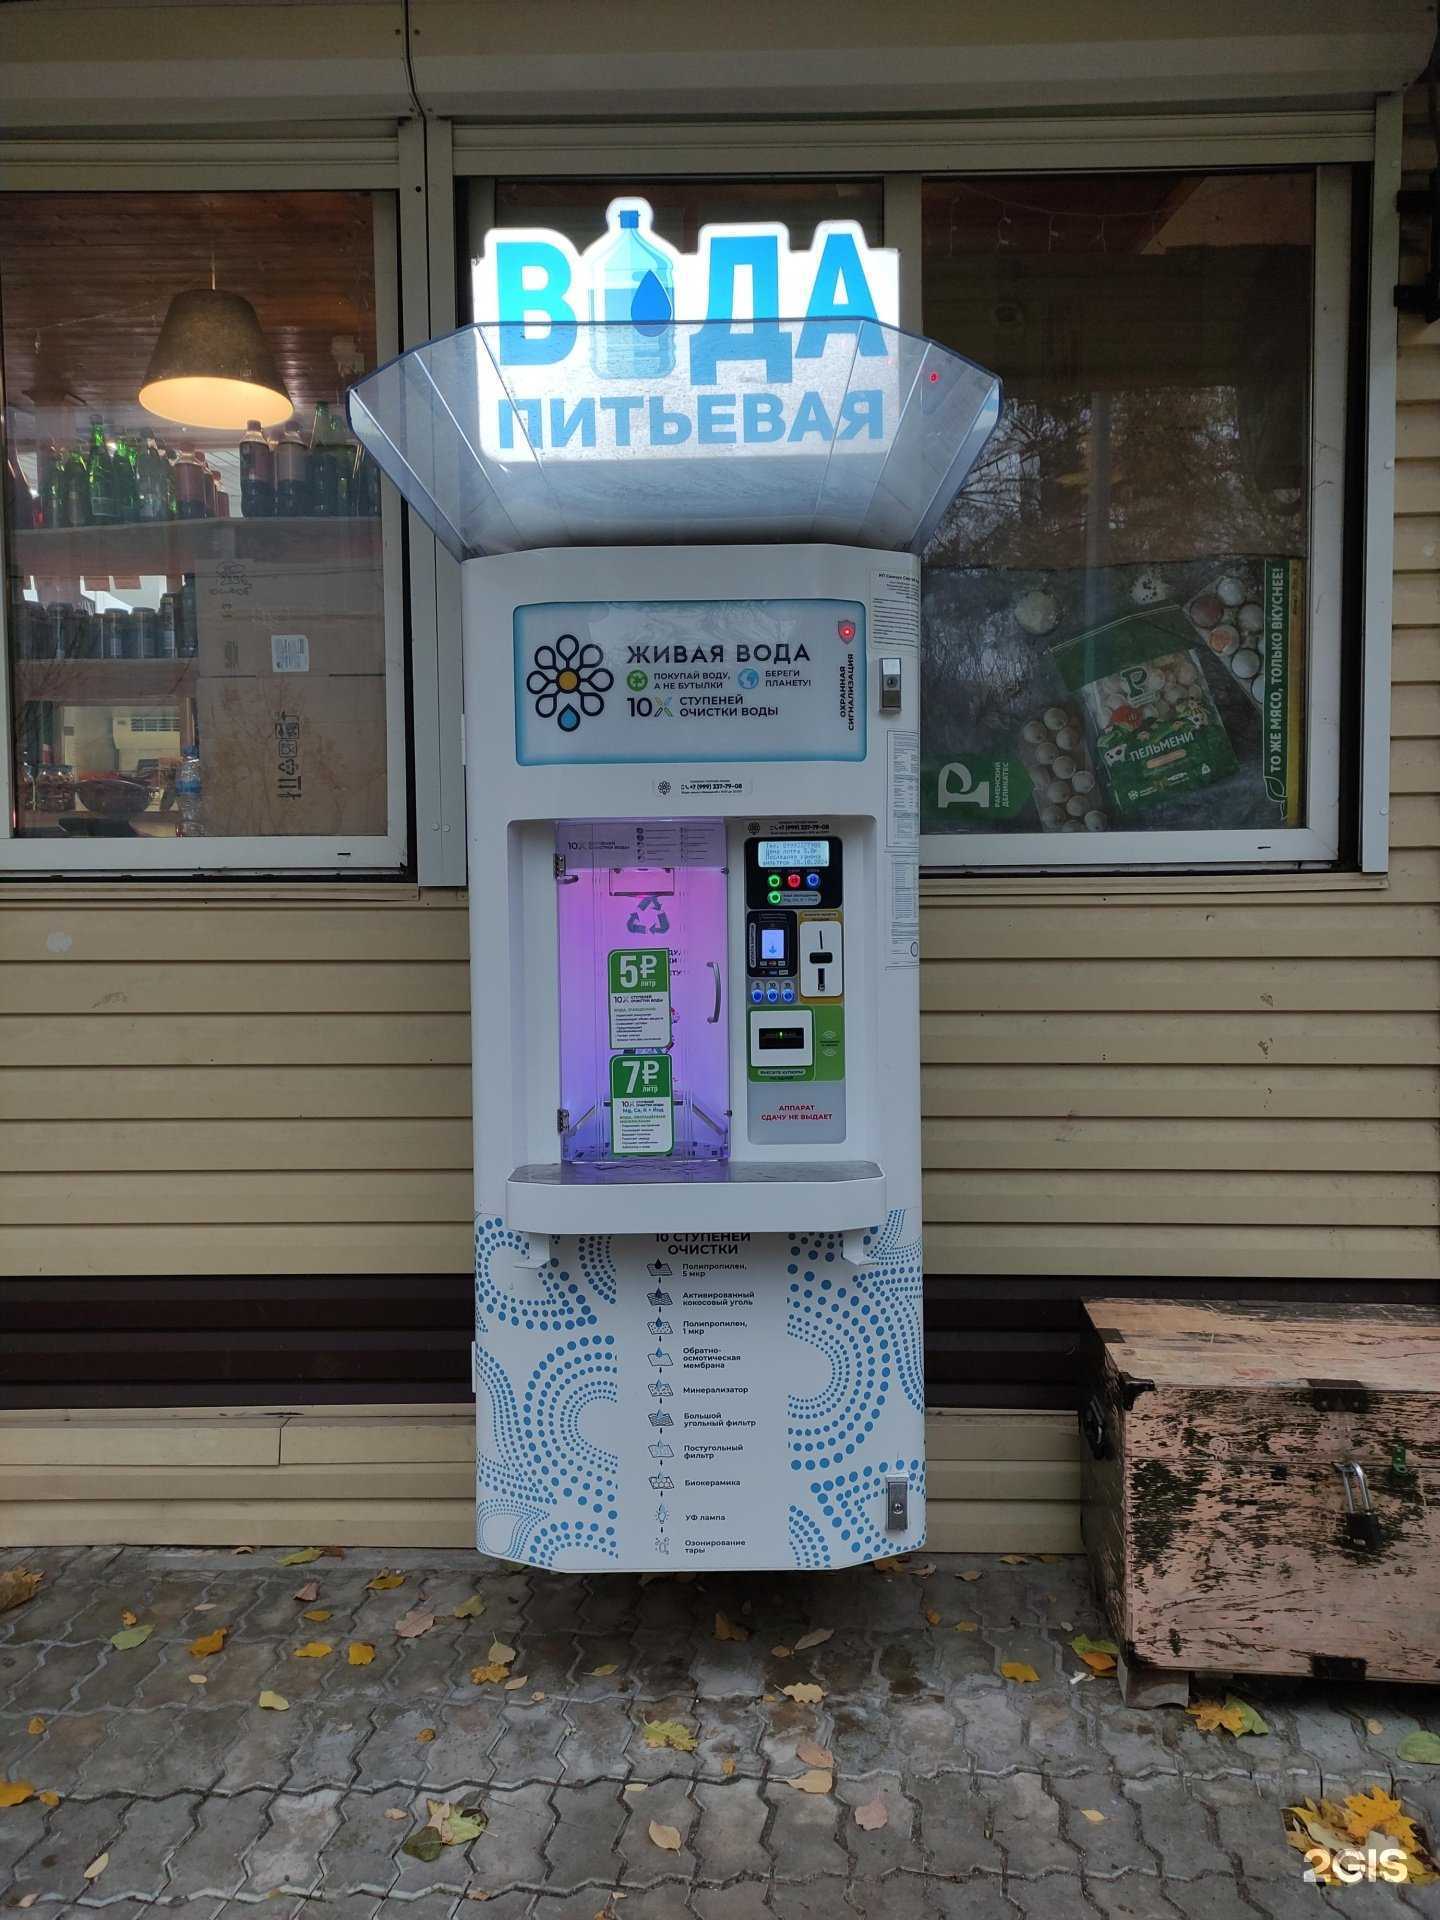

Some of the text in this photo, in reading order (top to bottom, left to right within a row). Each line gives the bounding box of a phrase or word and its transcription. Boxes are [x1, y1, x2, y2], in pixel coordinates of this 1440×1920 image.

[499, 389, 885, 449] ПИТЬЕВАЯ
[627, 643, 810, 664] ЖИВАЯ ВОДА
[654, 671, 730, 680] ПОКУПАЙ ВОДУ,
[1270, 568, 1284, 773] ТО ЖЕ МЯСО, ТОЛЬКО ВКУСНЕЕ!
[680, 694, 743, 705] СТУПЕНЕЙ
[680, 707, 778, 717] ОЧИСТКИ ВОДЫ
[1130, 731, 1194, 761] ПЕЛЬМЕНИ
[801, 1113, 832, 1121] ВЫДАЕТ
[656, 1232, 751, 1242] 10 СТУПЕНЕЙ
[668, 1245, 738, 1255] ОЧИСТКИ
[683, 1347, 721, 1355] Обратно-
[684, 1362, 725, 1370] мембрана
[726, 1419, 756, 1427] фильтр
[684, 1444, 743, 1452] Постугольный
